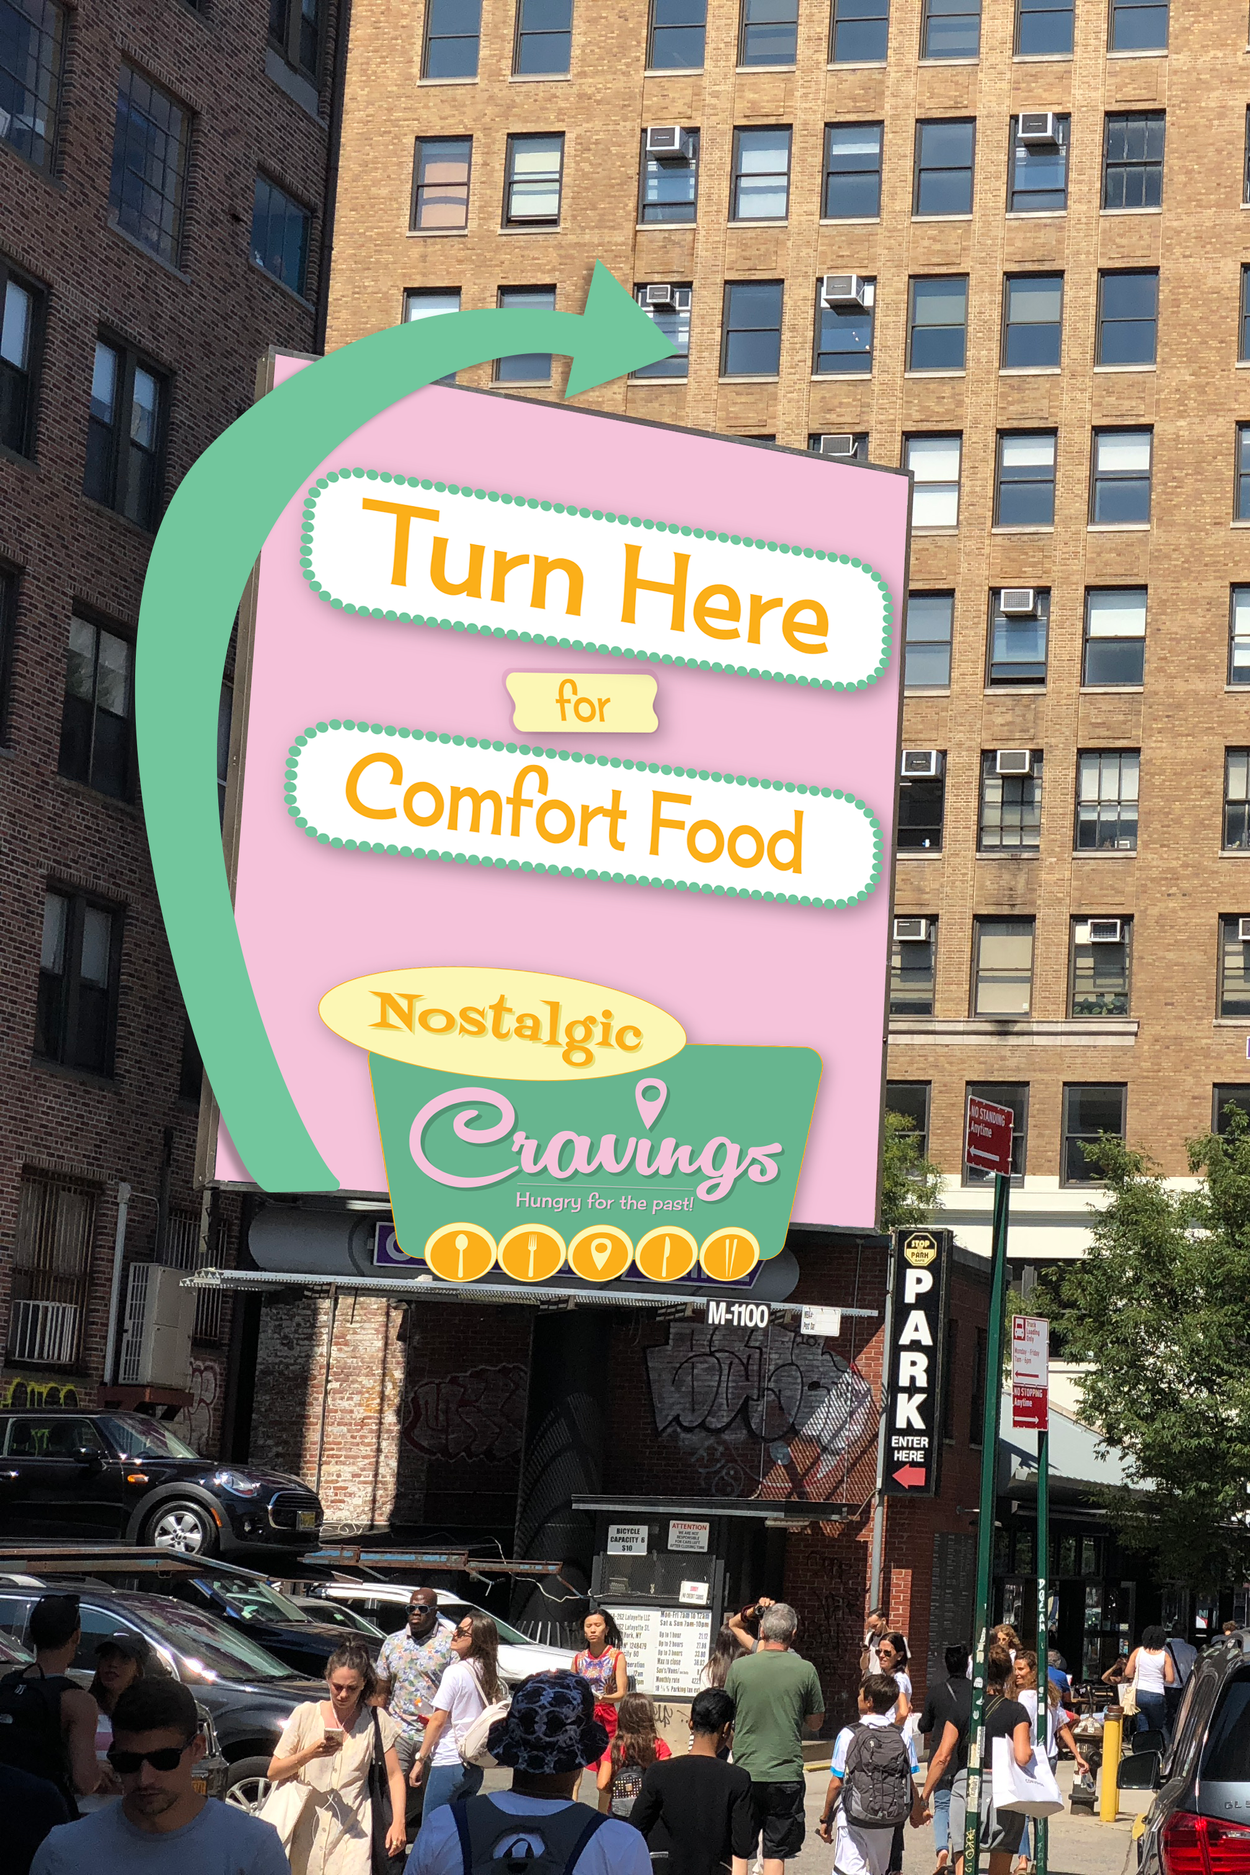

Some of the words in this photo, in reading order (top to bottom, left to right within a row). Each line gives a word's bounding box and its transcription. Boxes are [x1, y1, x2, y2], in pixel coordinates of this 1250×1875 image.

[362, 497, 584, 617] Turn
[620, 543, 829, 655] Here
[555, 678, 611, 723] for
[345, 752, 627, 852] Comfort
[649, 790, 804, 875] Food
[368, 990, 645, 1068] Nostalgic
[971, 1105, 979, 1118] NO
[980, 1108, 1006, 1127] STANDING
[970, 1121, 992, 1138] Anytime
[409, 1086, 783, 1202] Cravings
[516, 1192, 582, 1213] Hungry
[587, 1192, 615, 1210] for
[619, 1195, 648, 1210] the
[652, 1196, 695, 1215] past!
[911, 1240, 930, 1248] STOP
[708, 1301, 769, 1329] M-1100
[1026, 1329, 1040, 1337] Loading
[1026, 1336, 1034, 1344] Only
[895, 1268, 934, 1430] PARK
[1014, 1387, 1021, 1396] NO
[1021, 1387, 1043, 1398] STOPPING
[1014, 1398, 1033, 1408] Anytime
[891, 1436, 929, 1448] ENTER
[894, 1450, 925, 1462] HERE
[671, 1522, 707, 1531] ATTENTION
[610, 1536, 639, 1544] CAPACITY
[660, 1619, 668, 1627] Sat
[1224, 1800, 1242, 1810] GL
